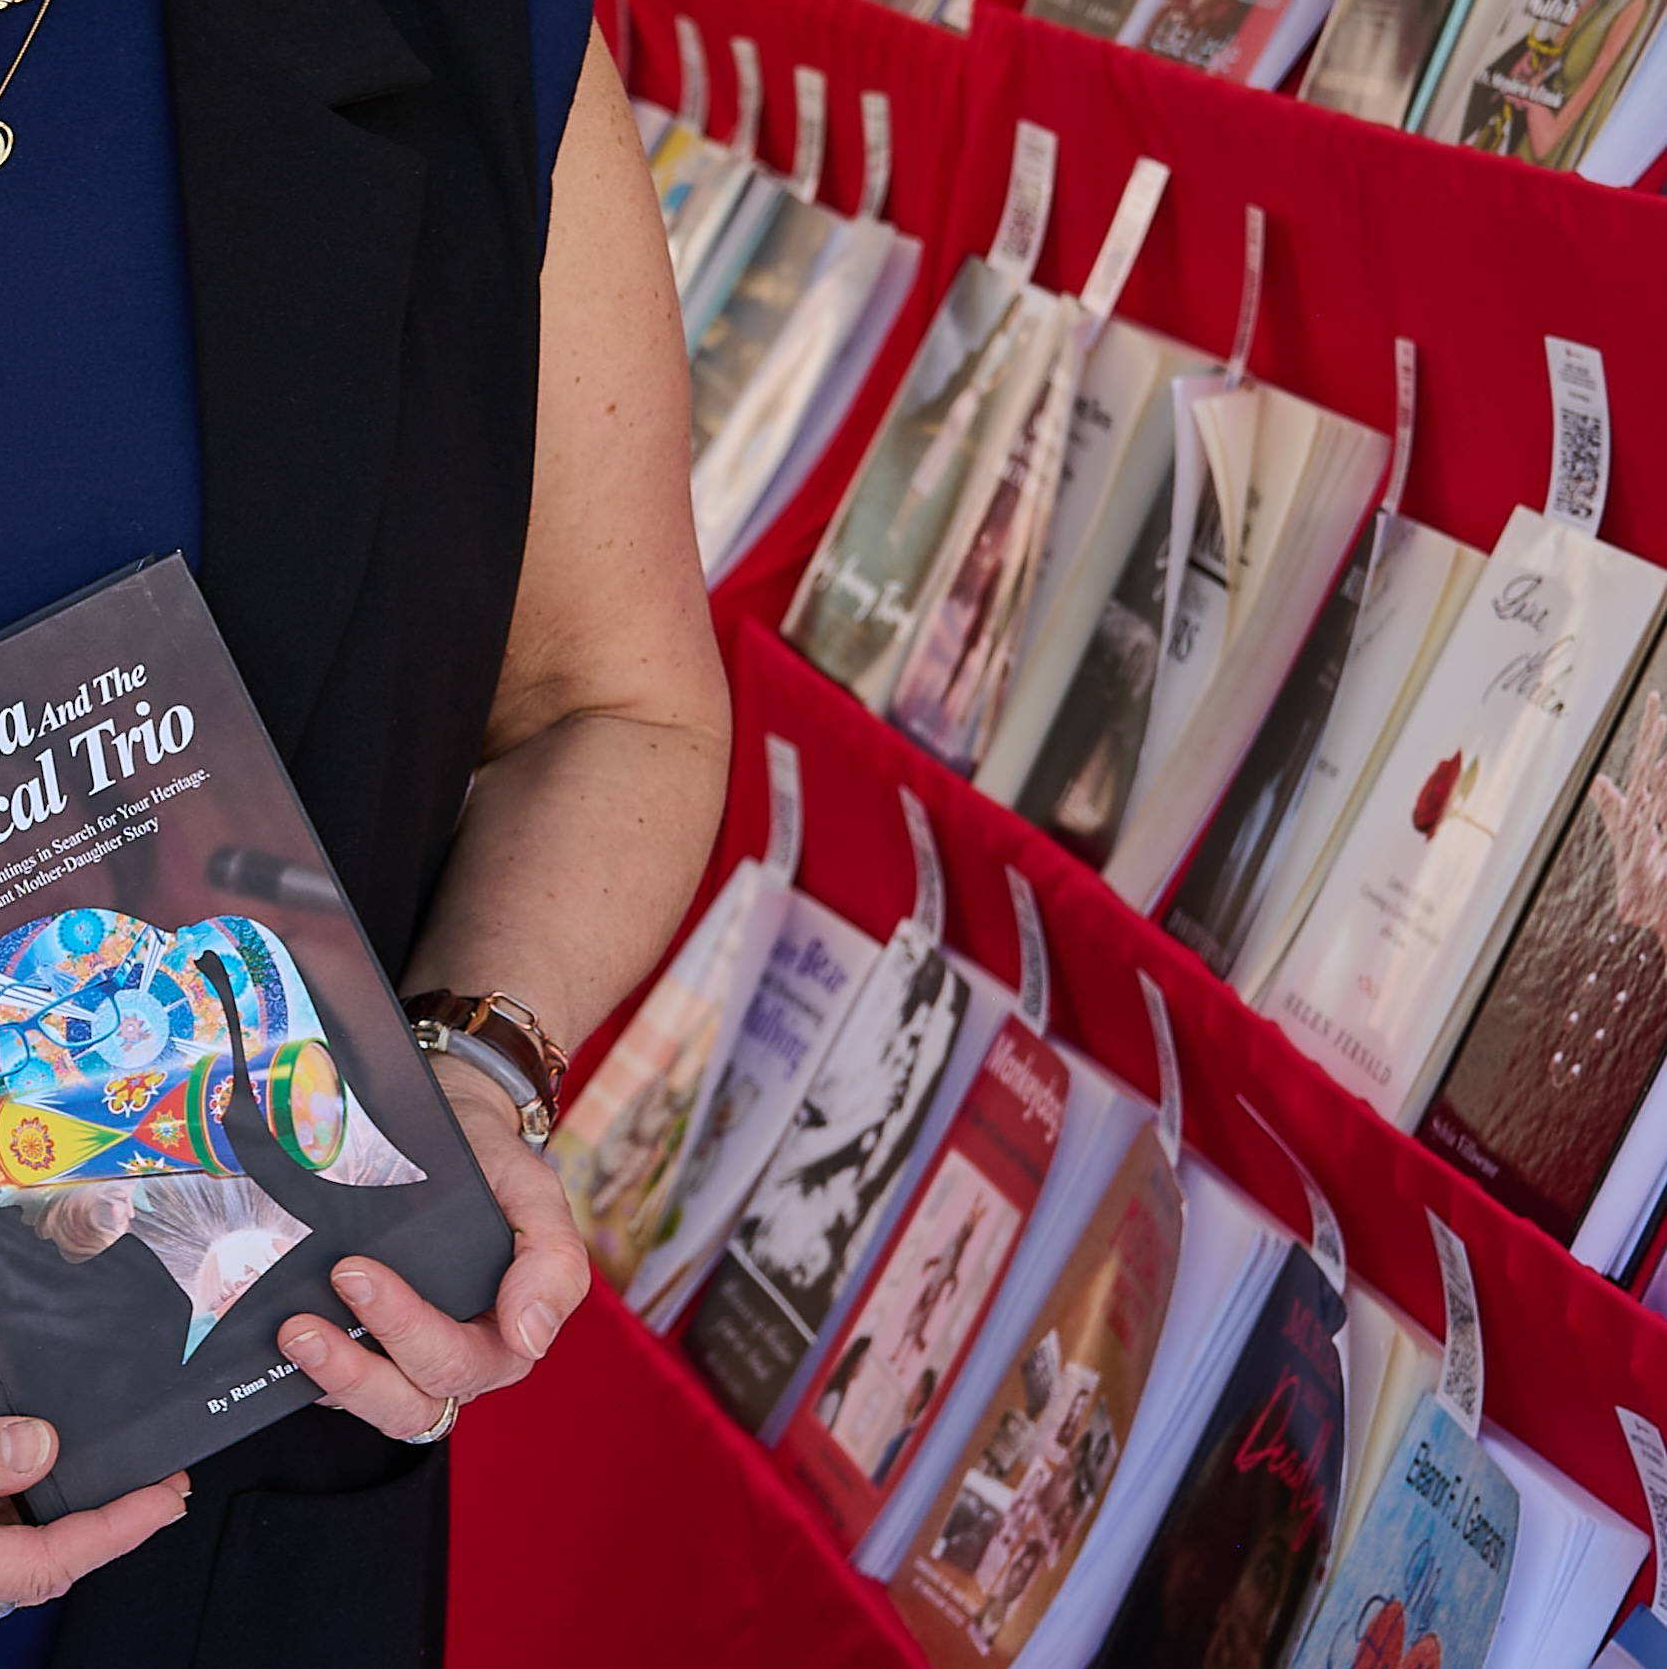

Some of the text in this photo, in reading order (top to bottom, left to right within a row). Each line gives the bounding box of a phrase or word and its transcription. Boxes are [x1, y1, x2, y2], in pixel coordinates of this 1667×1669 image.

[37, 685, 92, 737] And
[92, 663, 147, 706] The
[70, 700, 195, 796] Trio
[37, 848, 52, 862] in
[51, 825, 97, 855] Search
[97, 813, 117, 832] for
[117, 797, 151, 820] Your
[150, 768, 211, 804] Heritage.
[14, 835, 124, 898] Mother-Daughter
[123, 816, 160, 841] Story
[207, 1361, 301, 1414] By Rima Mar
[1406, 1440, 1450, 1507] Eleanor
